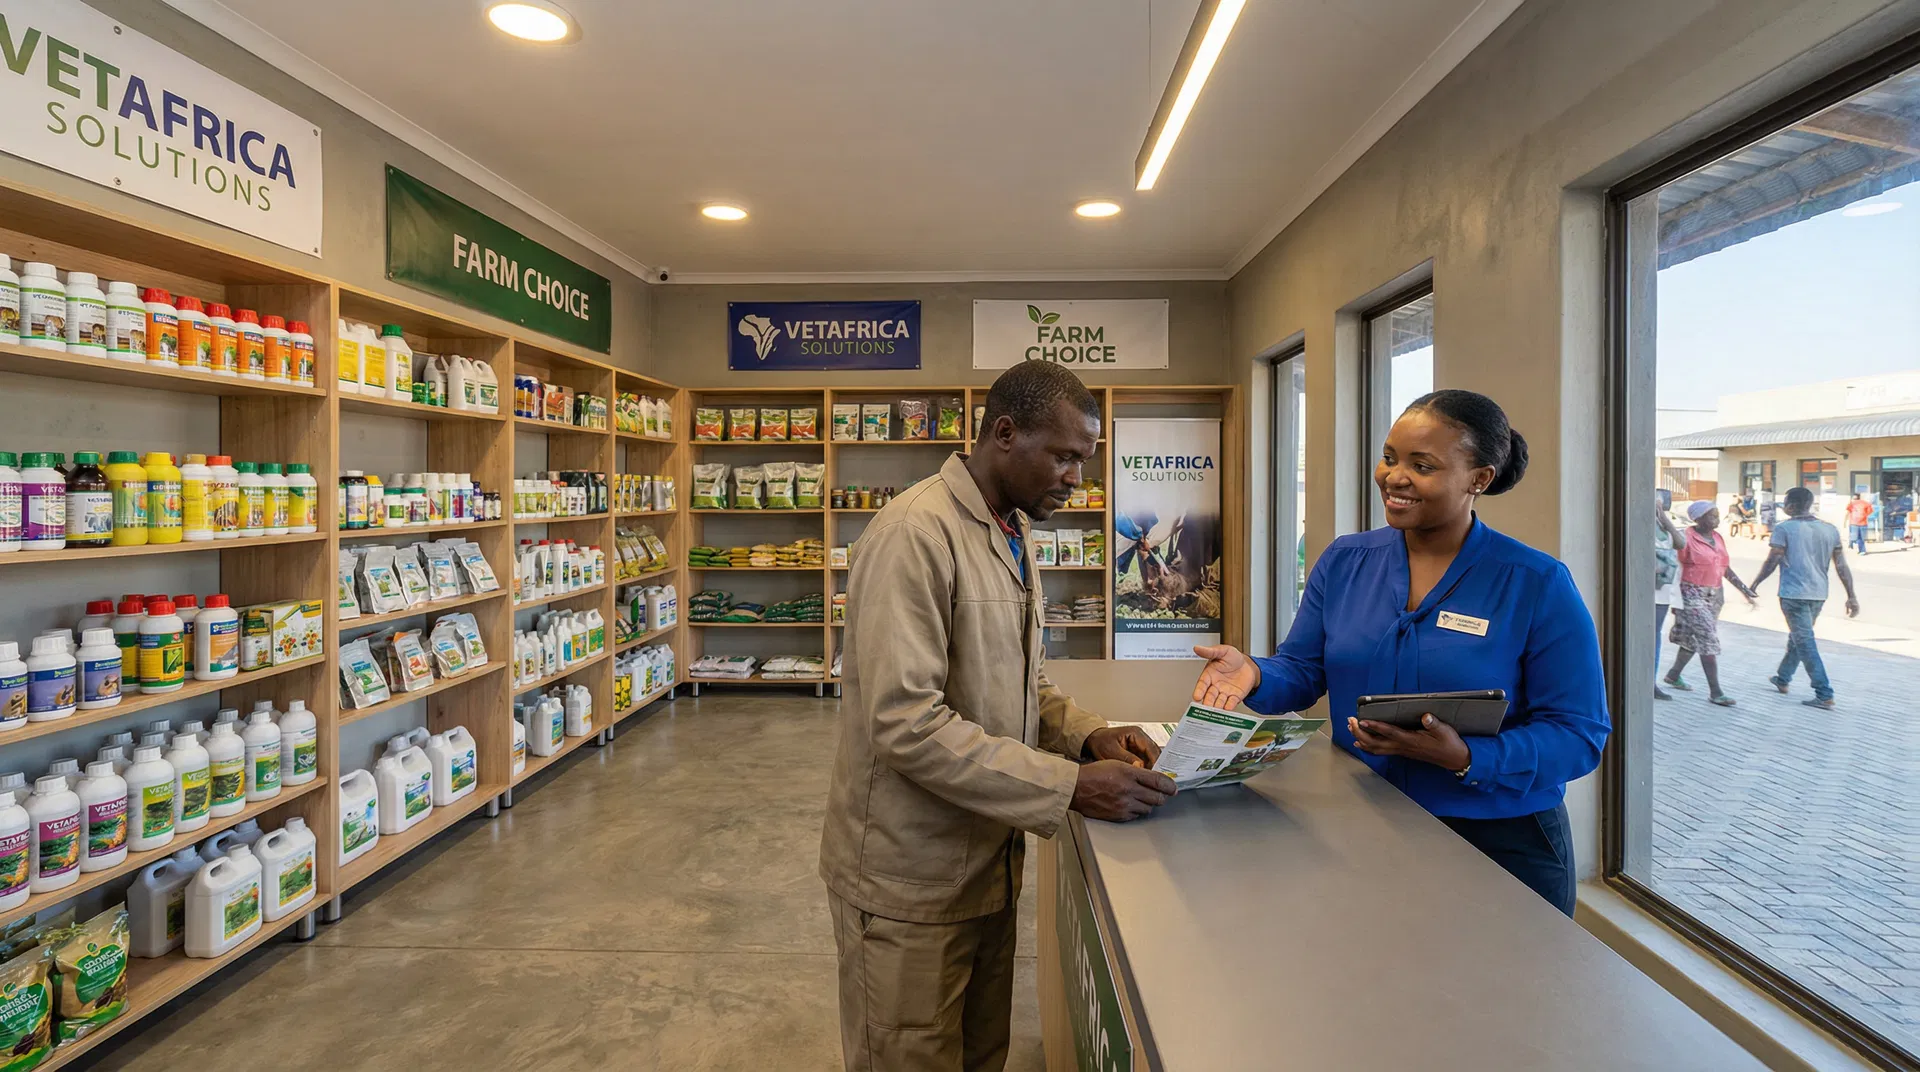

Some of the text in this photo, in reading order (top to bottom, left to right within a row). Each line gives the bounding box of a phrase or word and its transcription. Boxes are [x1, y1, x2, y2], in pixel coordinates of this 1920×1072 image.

[0, 13, 296, 189] VETAFRICA
[46, 101, 271, 212] SOLUTIONS
[453, 233, 589, 321] FARM CHOICE
[784, 319, 910, 341] VETAFRICA
[1037, 325, 1104, 344] FARM
[800, 341, 895, 356] SOLUTIONS
[1025, 345, 1116, 364] CHOICE
[1121, 456, 1214, 469] VETAFRICA
[1131, 471, 1204, 482] SOLUTIONS
[1058, 840, 1117, 1072] VETAFRIC
